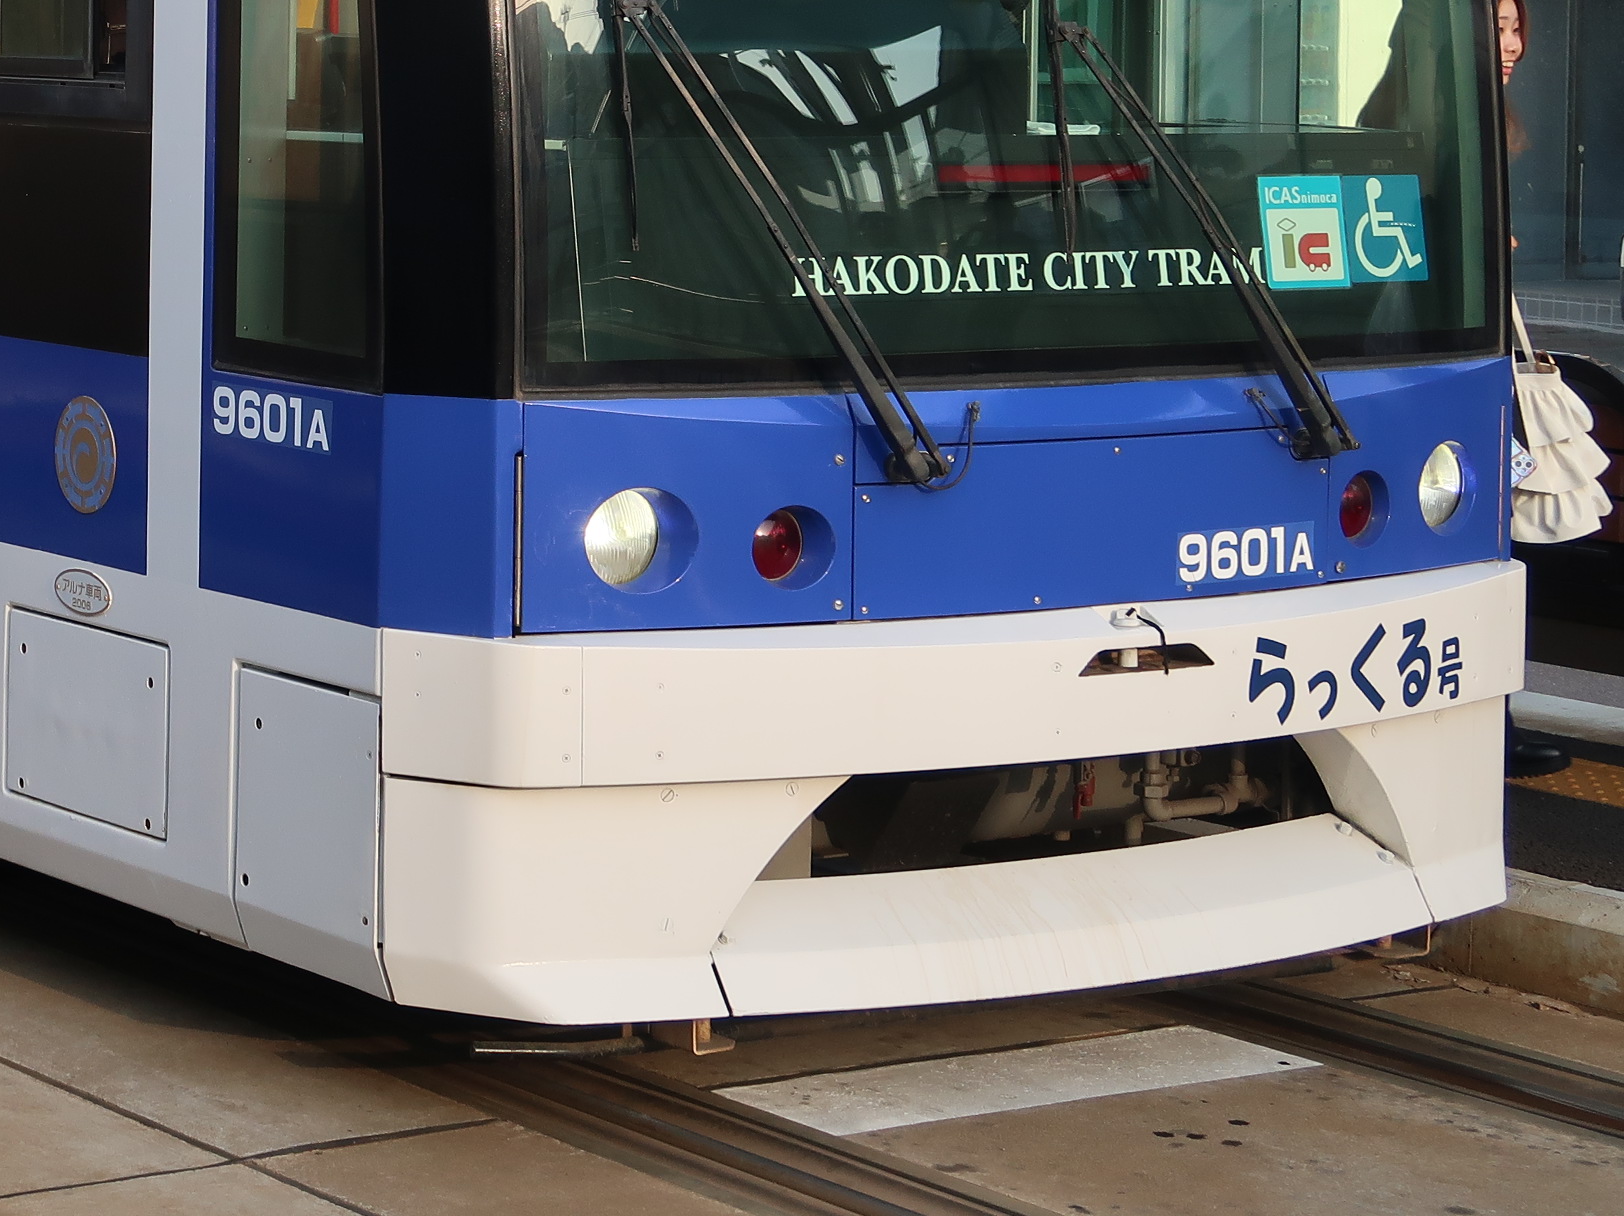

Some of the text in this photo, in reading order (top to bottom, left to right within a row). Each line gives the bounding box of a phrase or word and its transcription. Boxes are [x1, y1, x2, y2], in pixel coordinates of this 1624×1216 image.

[792, 253, 1033, 297] HAKODATE
[1043, 249, 1139, 290] CITY
[213, 386, 330, 452] 9601A
[1178, 525, 1314, 583] 9601A
[61, 577, 104, 603] アルナ車両
[1248, 617, 1464, 725] らっくる号
